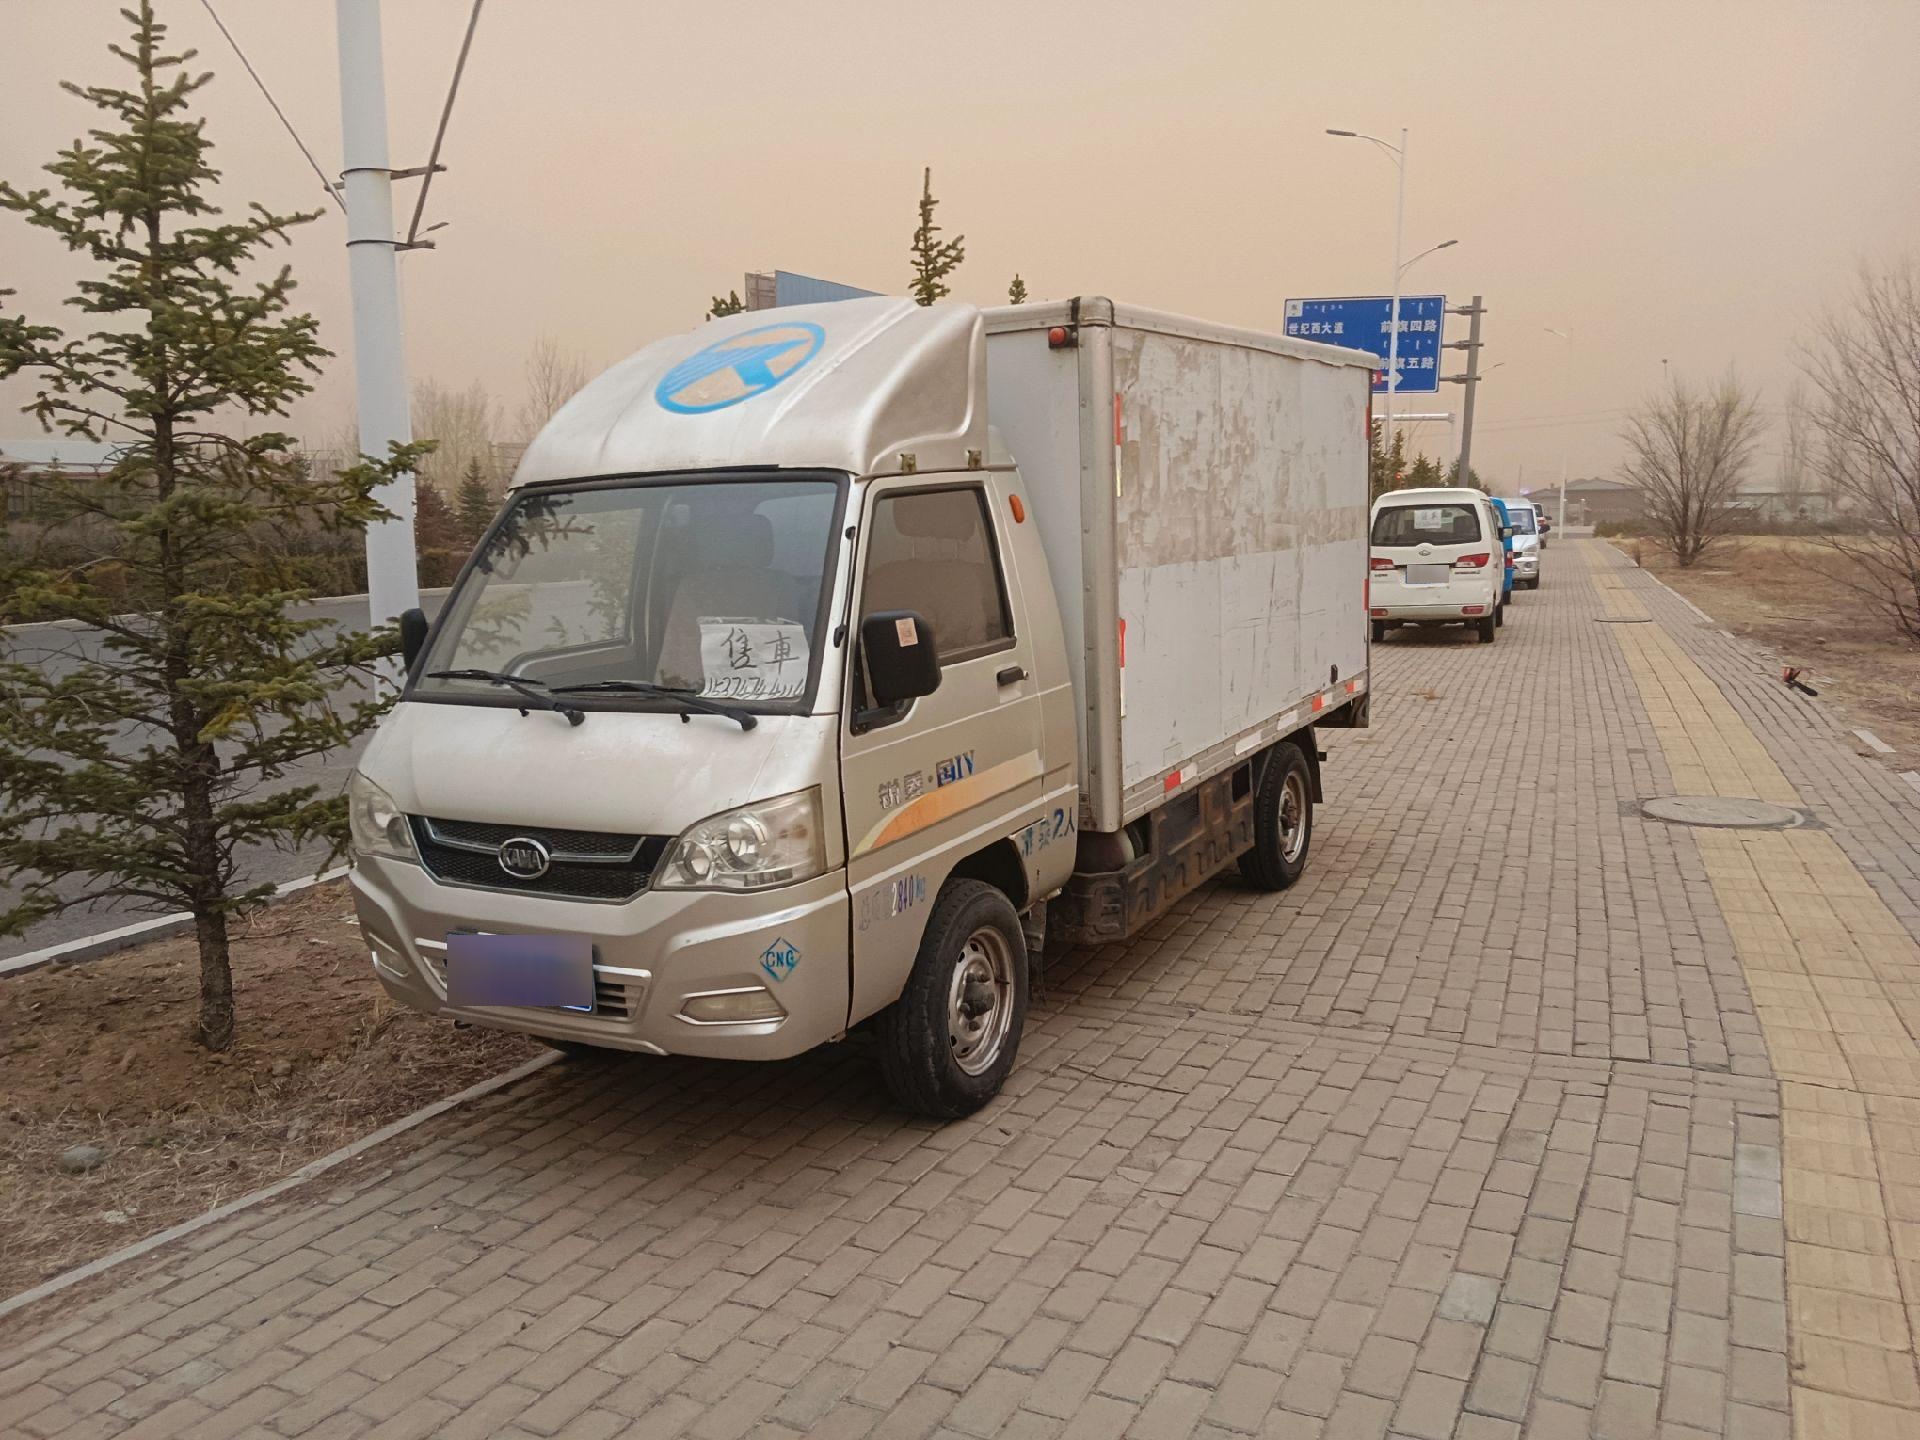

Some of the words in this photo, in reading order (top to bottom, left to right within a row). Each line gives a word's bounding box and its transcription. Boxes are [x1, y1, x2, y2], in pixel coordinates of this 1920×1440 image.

[1288, 322, 1344, 335] 世纪西大道
[765, 949, 795, 969] CNG
